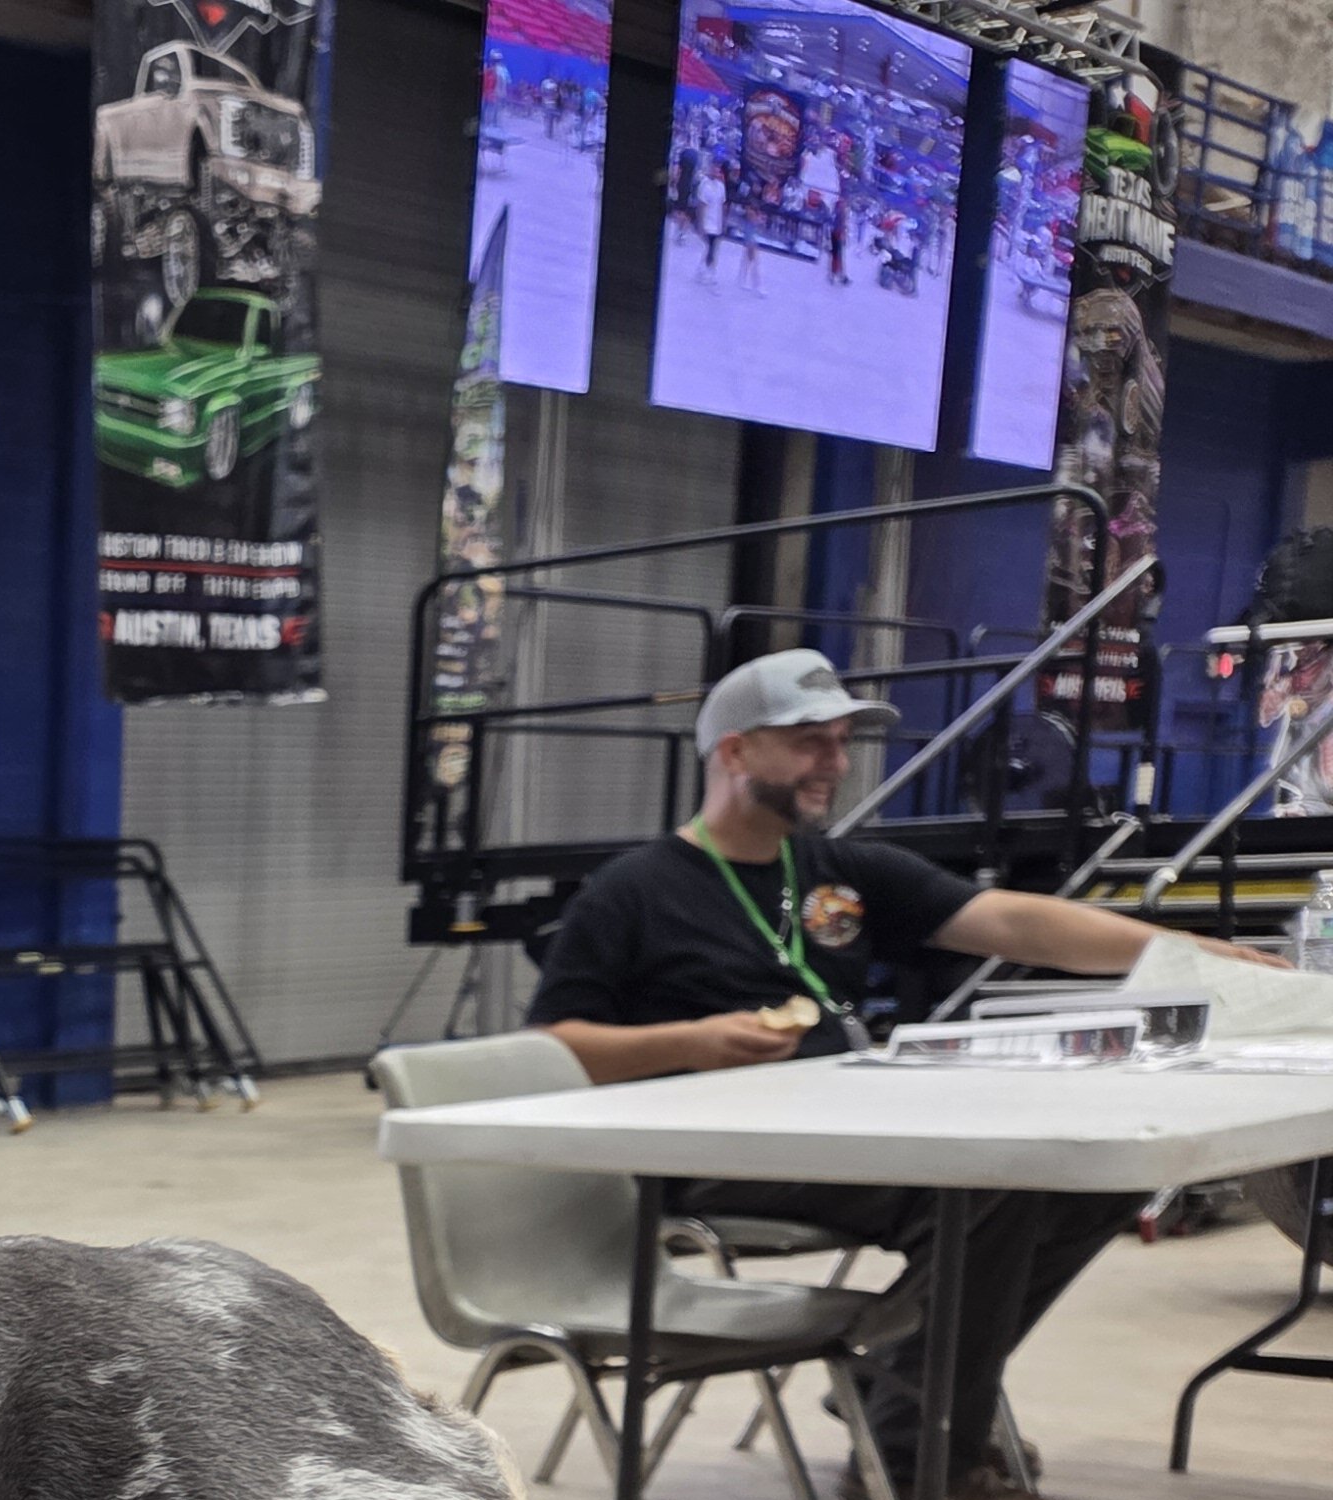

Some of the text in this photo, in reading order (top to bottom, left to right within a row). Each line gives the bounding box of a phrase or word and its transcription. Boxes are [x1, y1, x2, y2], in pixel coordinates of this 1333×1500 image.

[1107, 165, 1152, 210] TEXAS
[1079, 191, 1175, 266] HEAT WAVE
[208, 612, 282, 650] TEXAS
